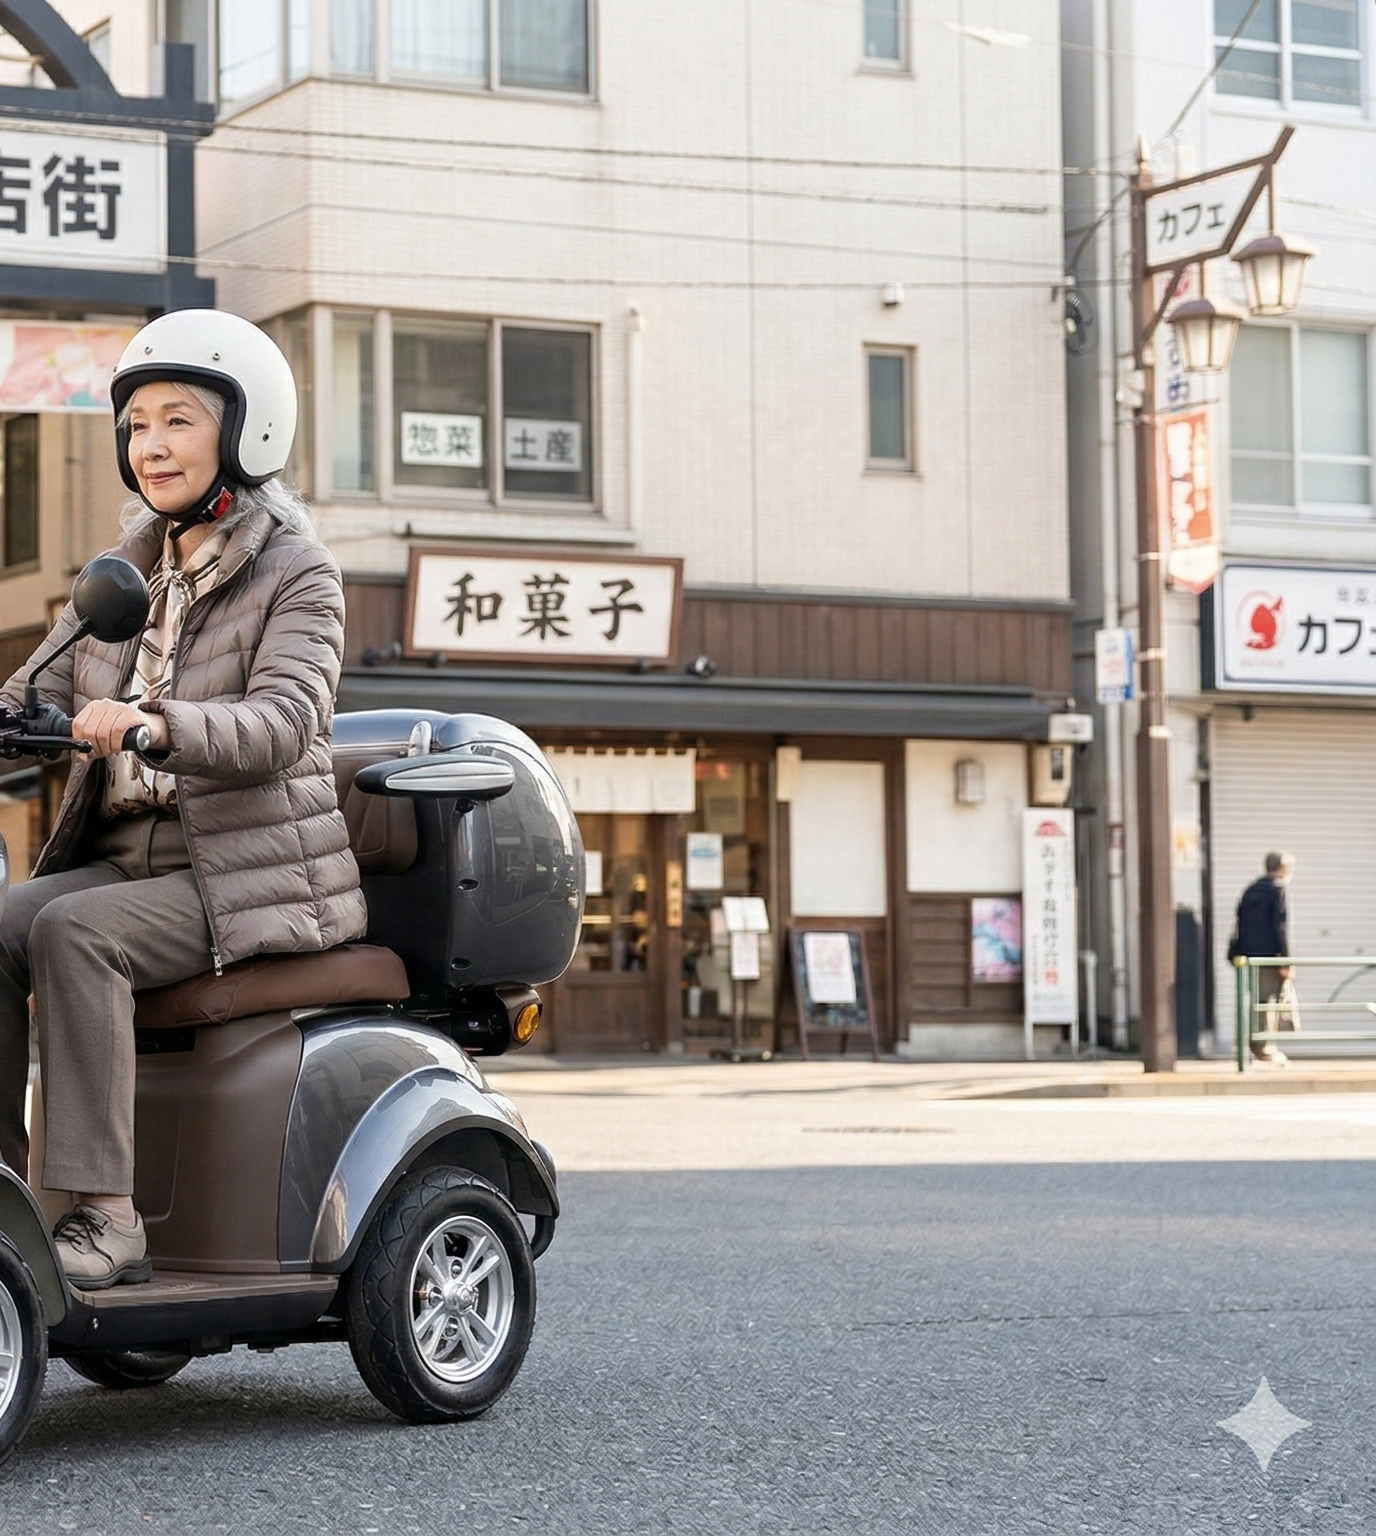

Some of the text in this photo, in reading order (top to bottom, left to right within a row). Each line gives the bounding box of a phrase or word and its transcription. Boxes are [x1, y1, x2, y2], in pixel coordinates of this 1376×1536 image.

[1158, 203, 1224, 243] カフェ
[409, 421, 473, 459] 惣菜
[510, 426, 575, 464] 土産
[443, 572, 645, 641] 和菓子
